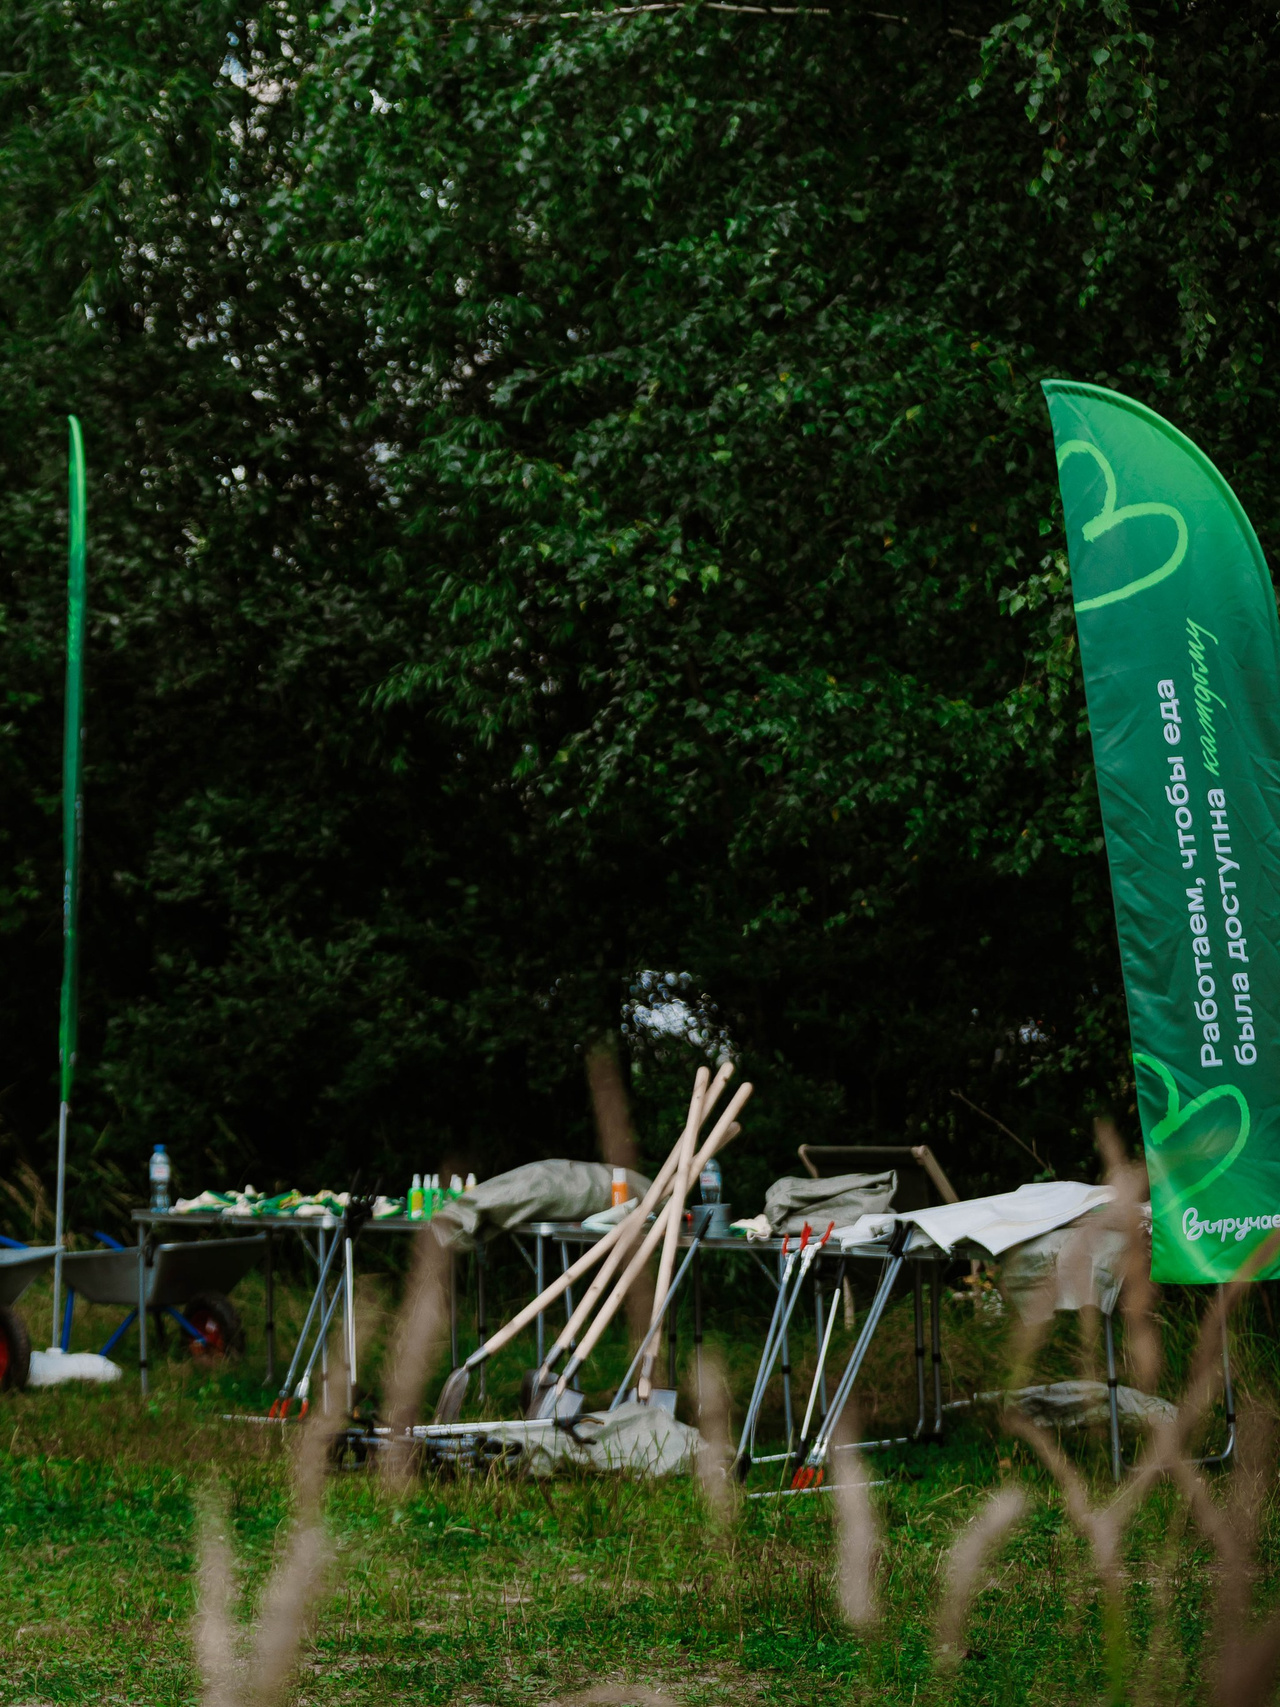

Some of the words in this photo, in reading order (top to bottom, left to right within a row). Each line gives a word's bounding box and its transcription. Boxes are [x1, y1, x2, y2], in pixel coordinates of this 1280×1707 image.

[1157, 679, 1182, 745] еда
[1164, 756, 1196, 869] чтобы
[1207, 788, 1249, 963] доступна
[1185, 877, 1223, 1068] Работаем,
[1231, 972, 1258, 1066] была
